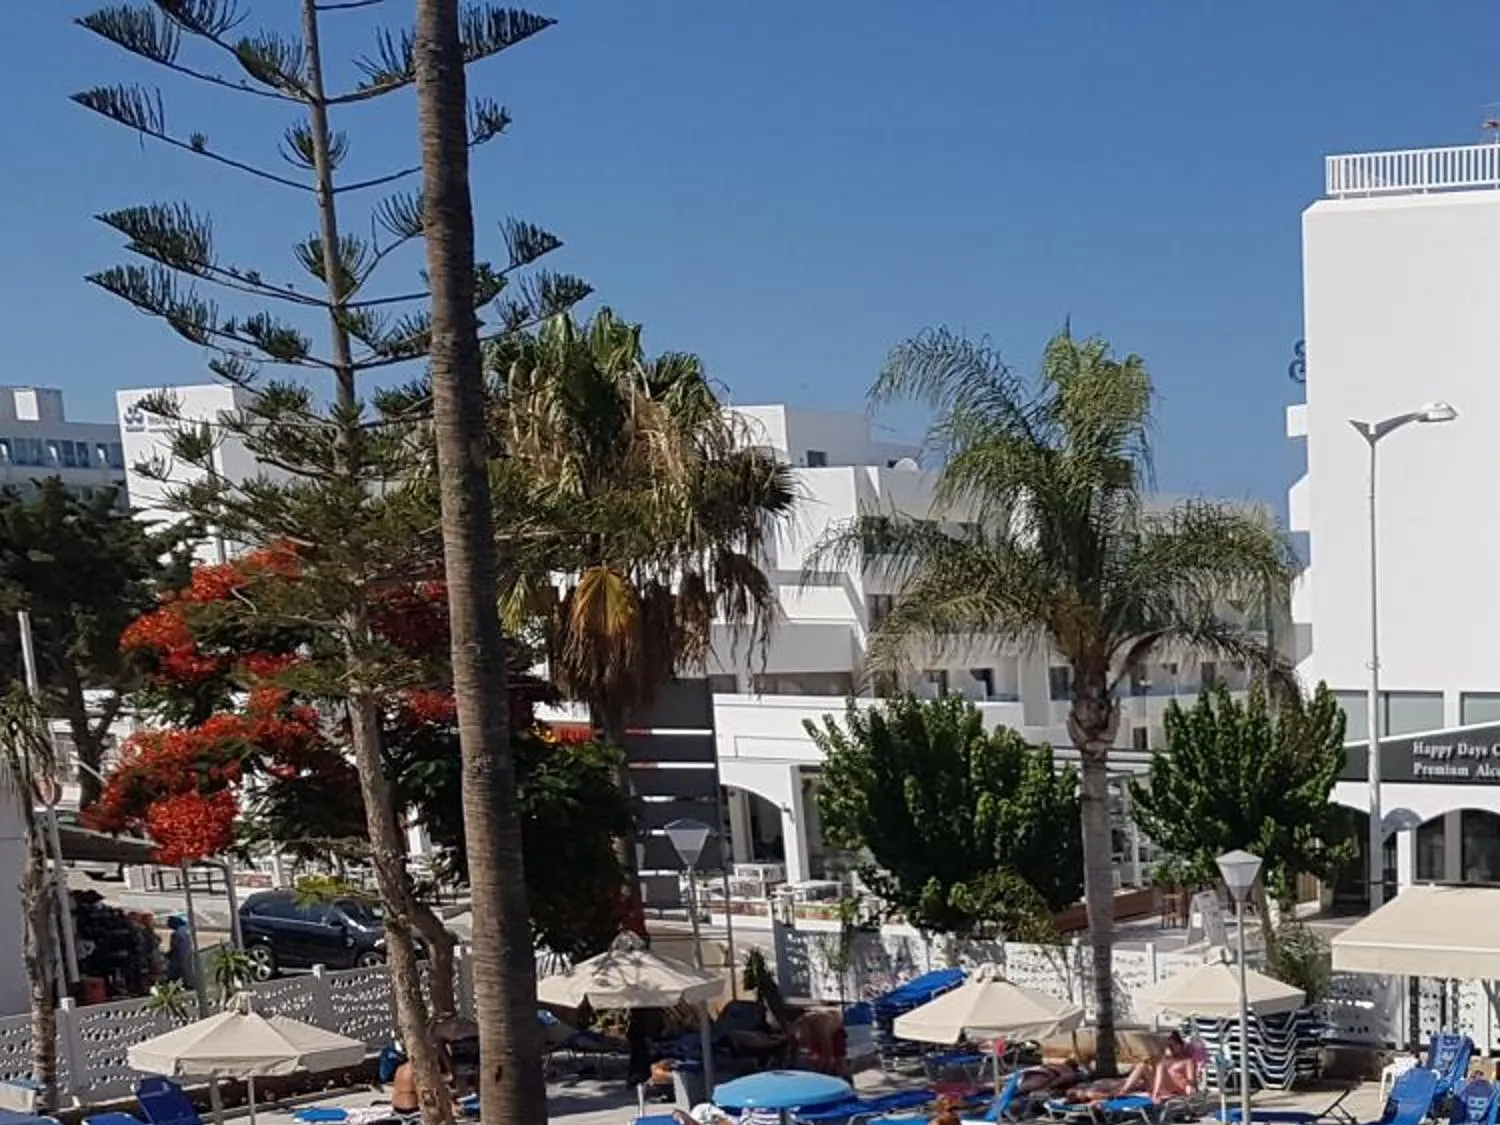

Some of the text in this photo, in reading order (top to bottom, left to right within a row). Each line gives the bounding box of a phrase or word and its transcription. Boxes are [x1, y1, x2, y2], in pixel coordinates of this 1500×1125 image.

[1412, 741, 1453, 759] Happy
[1457, 742, 1488, 759] Days
[1413, 761, 1469, 776] Premium
